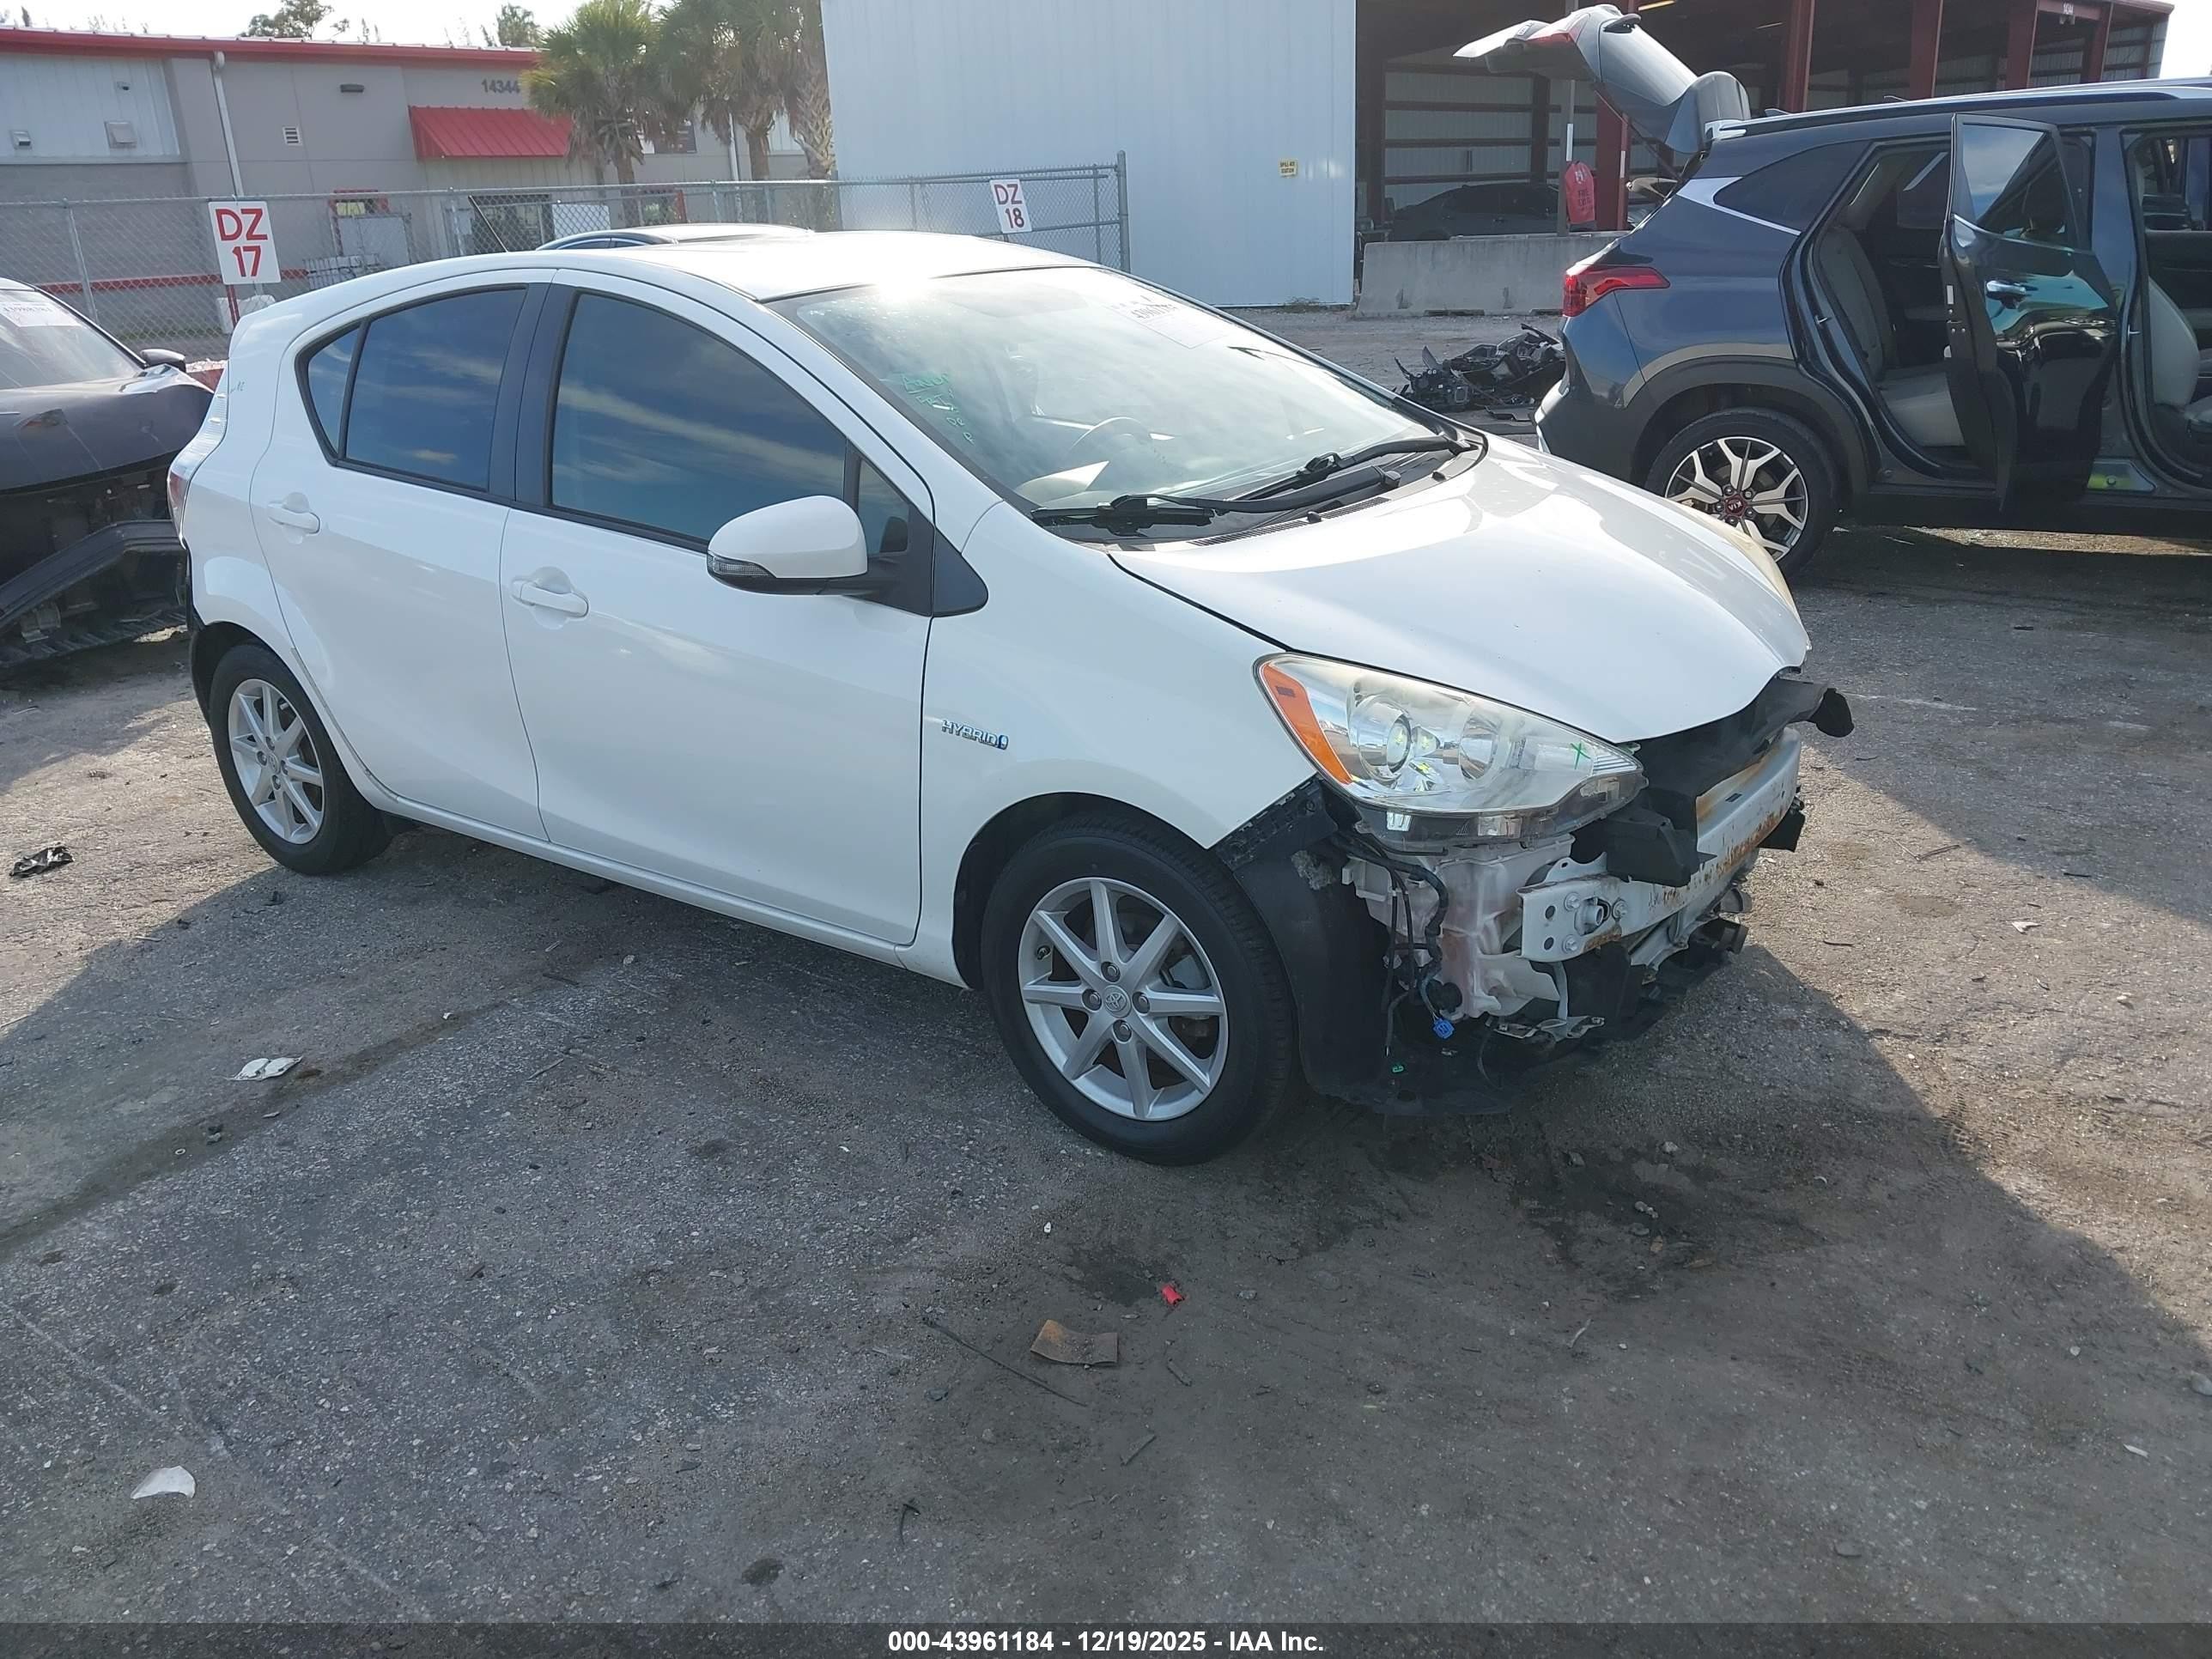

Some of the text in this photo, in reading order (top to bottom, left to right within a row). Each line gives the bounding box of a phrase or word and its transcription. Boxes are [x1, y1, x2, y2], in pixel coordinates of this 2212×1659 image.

[481, 77, 521, 94] 14344
[994, 183, 1023, 205] DZ
[215, 208, 268, 241] DZ
[1005, 207, 1024, 228] 18
[232, 245, 261, 277] 17
[1728, 500, 1743, 512] KIA
[941, 720, 999, 748] HYBRID
